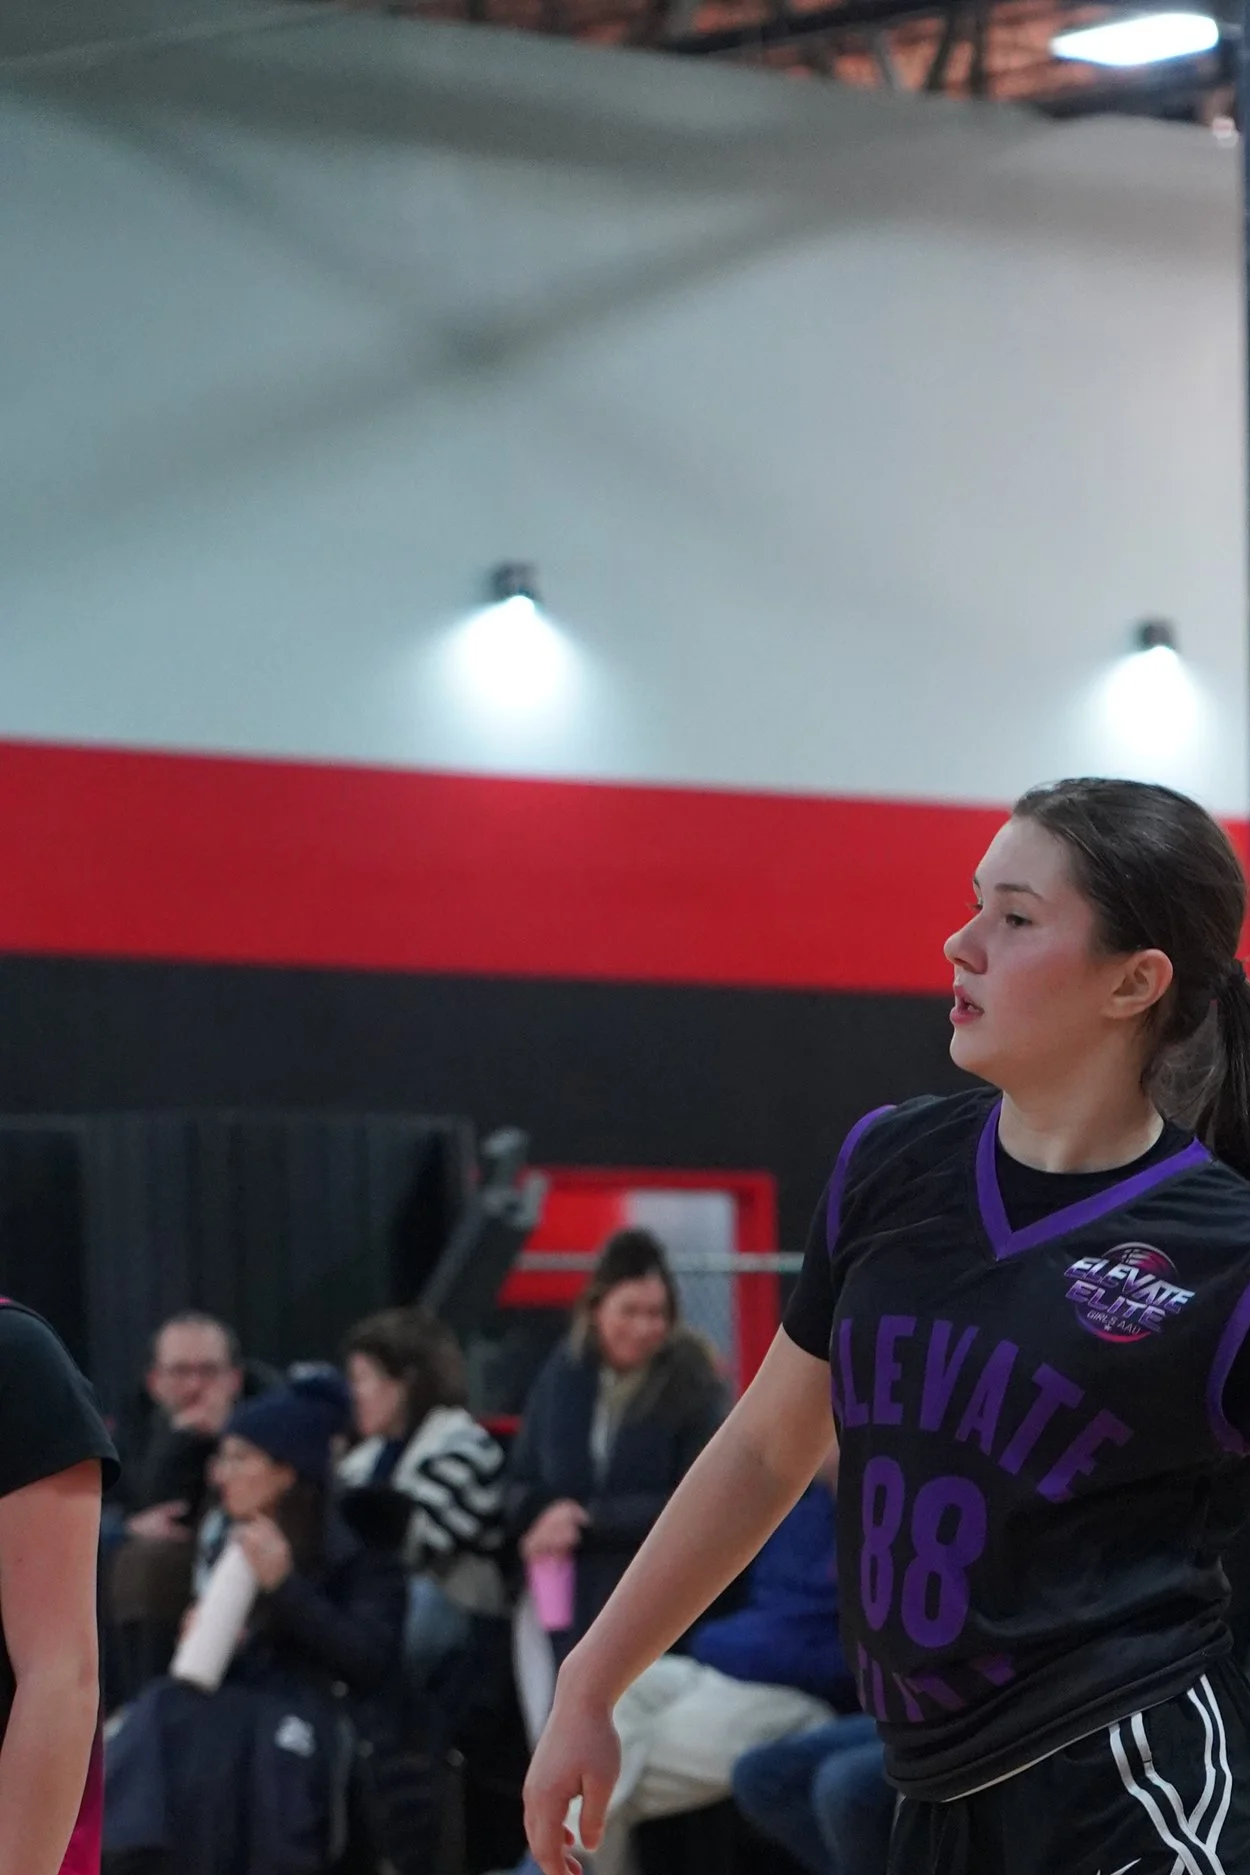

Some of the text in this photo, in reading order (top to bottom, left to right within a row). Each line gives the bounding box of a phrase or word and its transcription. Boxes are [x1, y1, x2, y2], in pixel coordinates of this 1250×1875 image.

[1063, 1256, 1196, 1314] ELEVATE
[1064, 1280, 1166, 1332] ELITE
[832, 1314, 1135, 1504] LEVATE
[859, 1454, 988, 1649] 88
